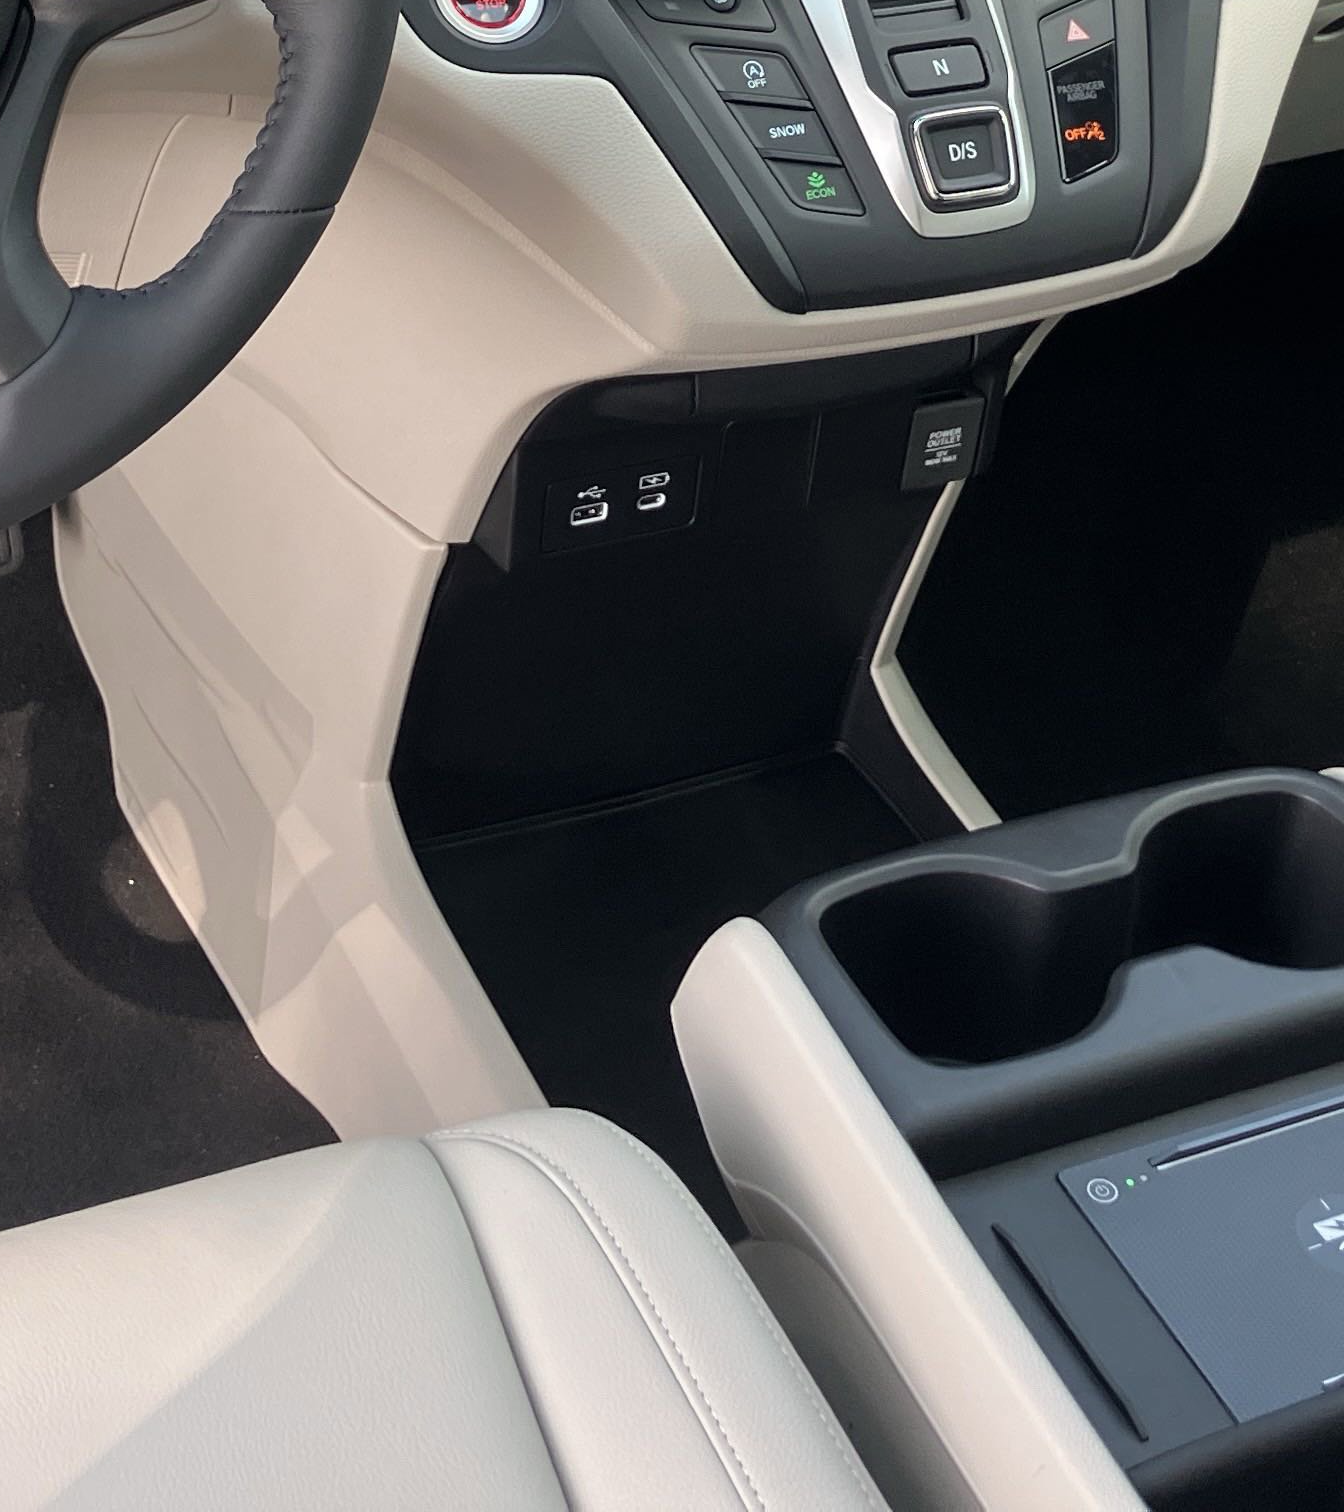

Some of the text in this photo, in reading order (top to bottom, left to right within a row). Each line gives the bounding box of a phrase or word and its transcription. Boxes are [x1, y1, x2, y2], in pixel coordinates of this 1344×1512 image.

[932, 58, 950, 76] N
[747, 78, 767, 89] OFF
[1056, 80, 1106, 94] PASSENGER
[768, 123, 805, 139] SNOW
[1064, 127, 1087, 141] OFF
[948, 141, 978, 162] D/S
[806, 187, 836, 201] ECON
